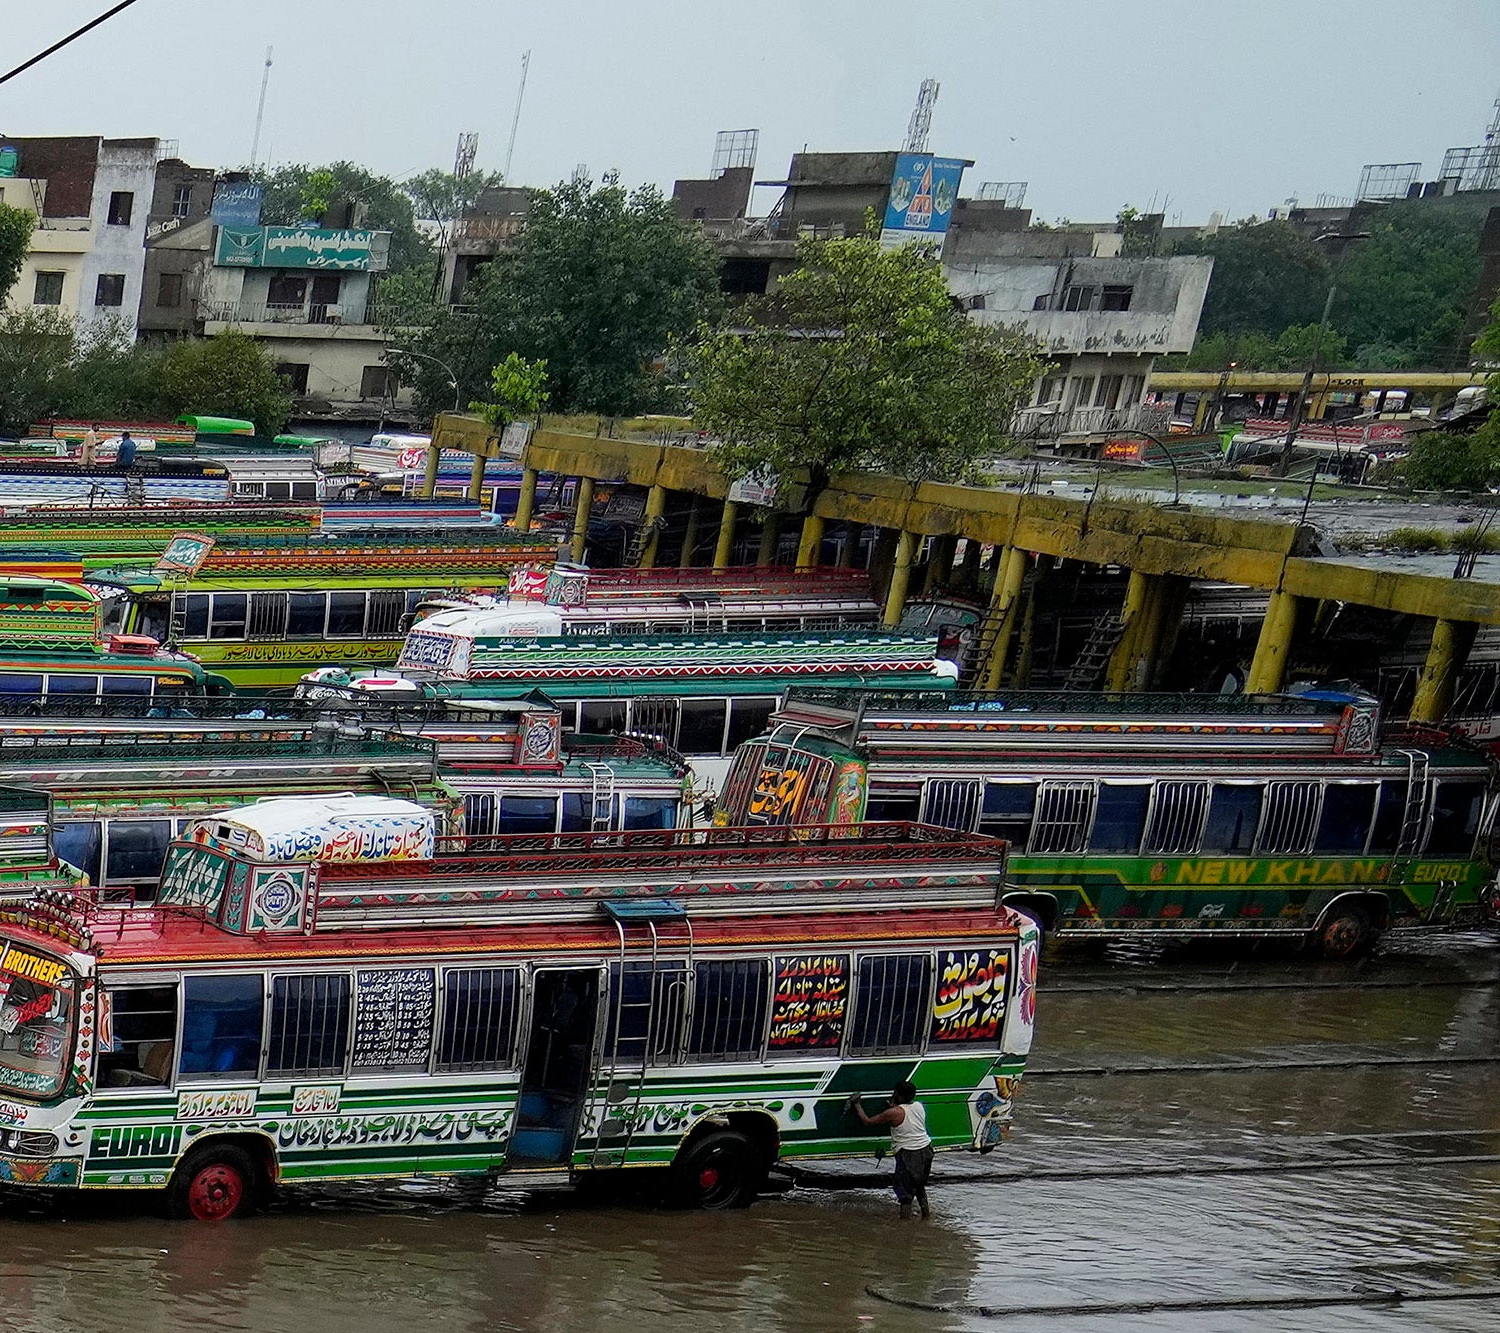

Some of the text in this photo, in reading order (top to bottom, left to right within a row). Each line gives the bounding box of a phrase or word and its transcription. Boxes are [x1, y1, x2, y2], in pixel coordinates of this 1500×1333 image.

[316, 828, 362, 861] لاہور
[1176, 860, 1257, 885] NEW
[1264, 859, 1376, 884] KHAN
[306, 867, 317, 931] SAEED
[3, 949, 68, 986] BROTHERS
